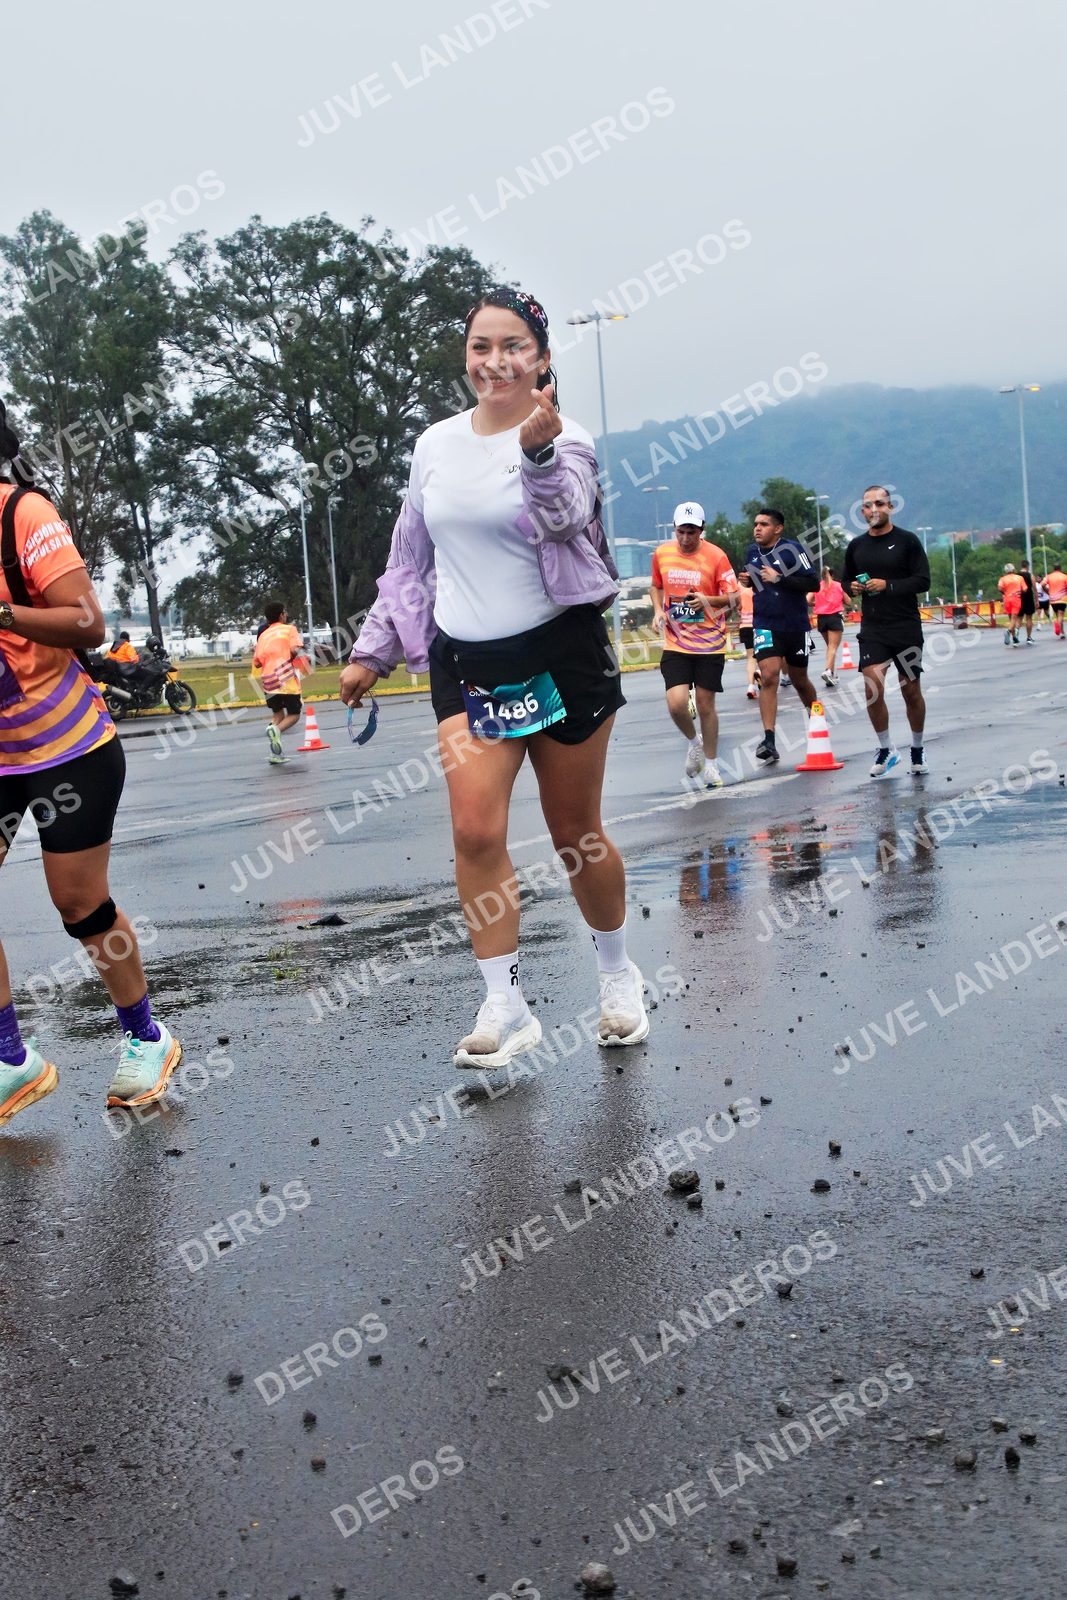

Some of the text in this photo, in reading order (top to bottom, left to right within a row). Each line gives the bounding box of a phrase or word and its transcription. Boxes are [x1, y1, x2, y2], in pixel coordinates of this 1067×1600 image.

[668, 569, 701, 580] CARRERA
[675, 606, 696, 616] 1476
[483, 692, 539, 720] 1486
